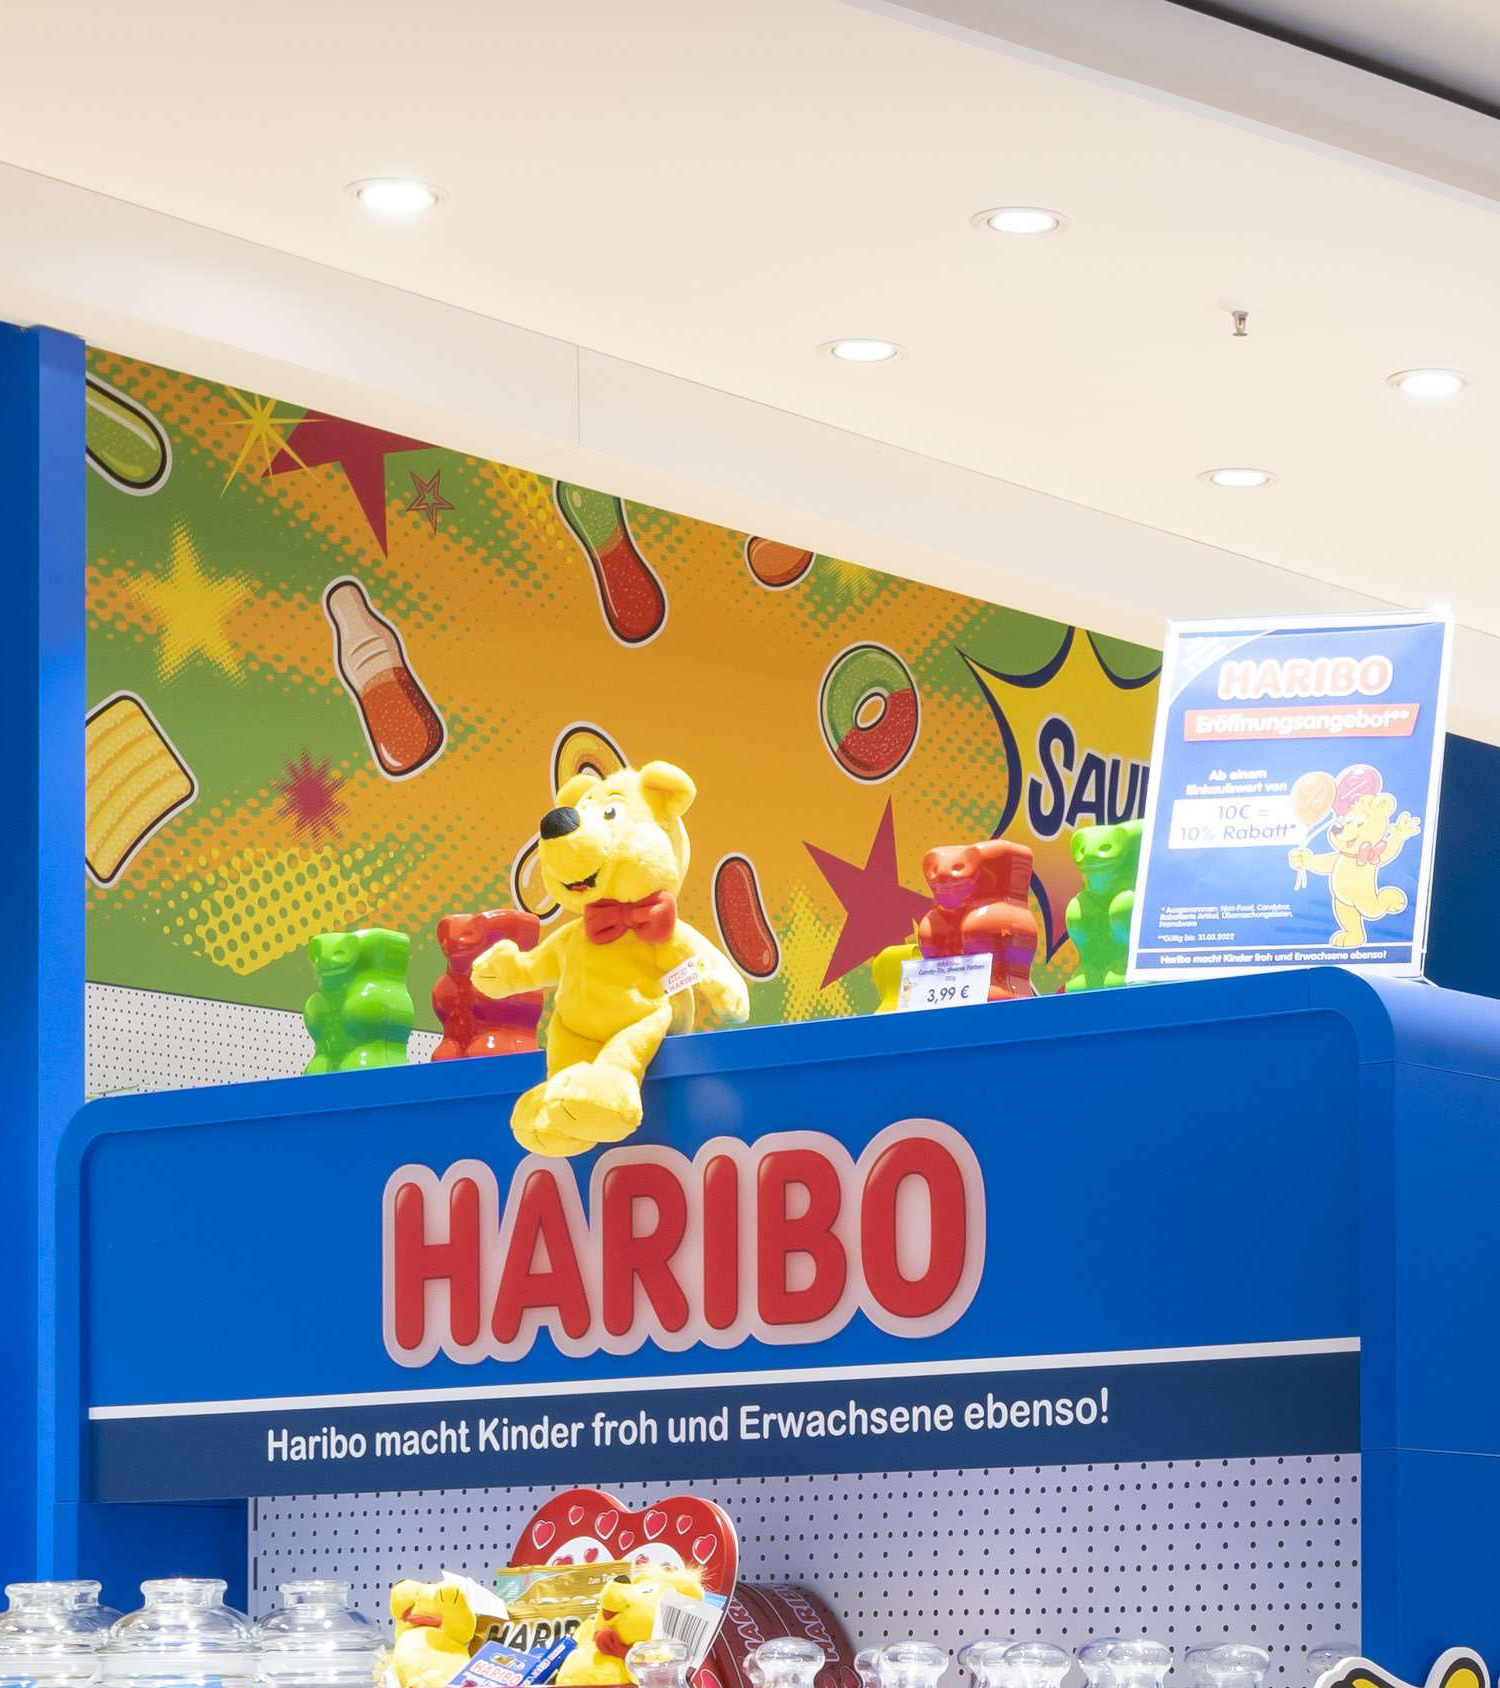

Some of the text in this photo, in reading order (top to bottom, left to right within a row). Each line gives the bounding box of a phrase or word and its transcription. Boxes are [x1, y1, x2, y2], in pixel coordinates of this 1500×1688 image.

[1219, 656, 1391, 698] HARIBO
[1027, 716, 1151, 838] SAU
[1209, 769, 1267, 782] Ab einem
[1161, 955, 1191, 965] Haribo
[1193, 954, 1221, 964] macht
[1223, 952, 1253, 963] Kinder
[1275, 951, 1292, 961] und
[927, 985, 969, 1004] 3,99 €
[393, 1136, 968, 1353] HARIBO
[266, 1386, 1111, 1465] Haribo macht Kinder froh und Erwachsene ebenso!
